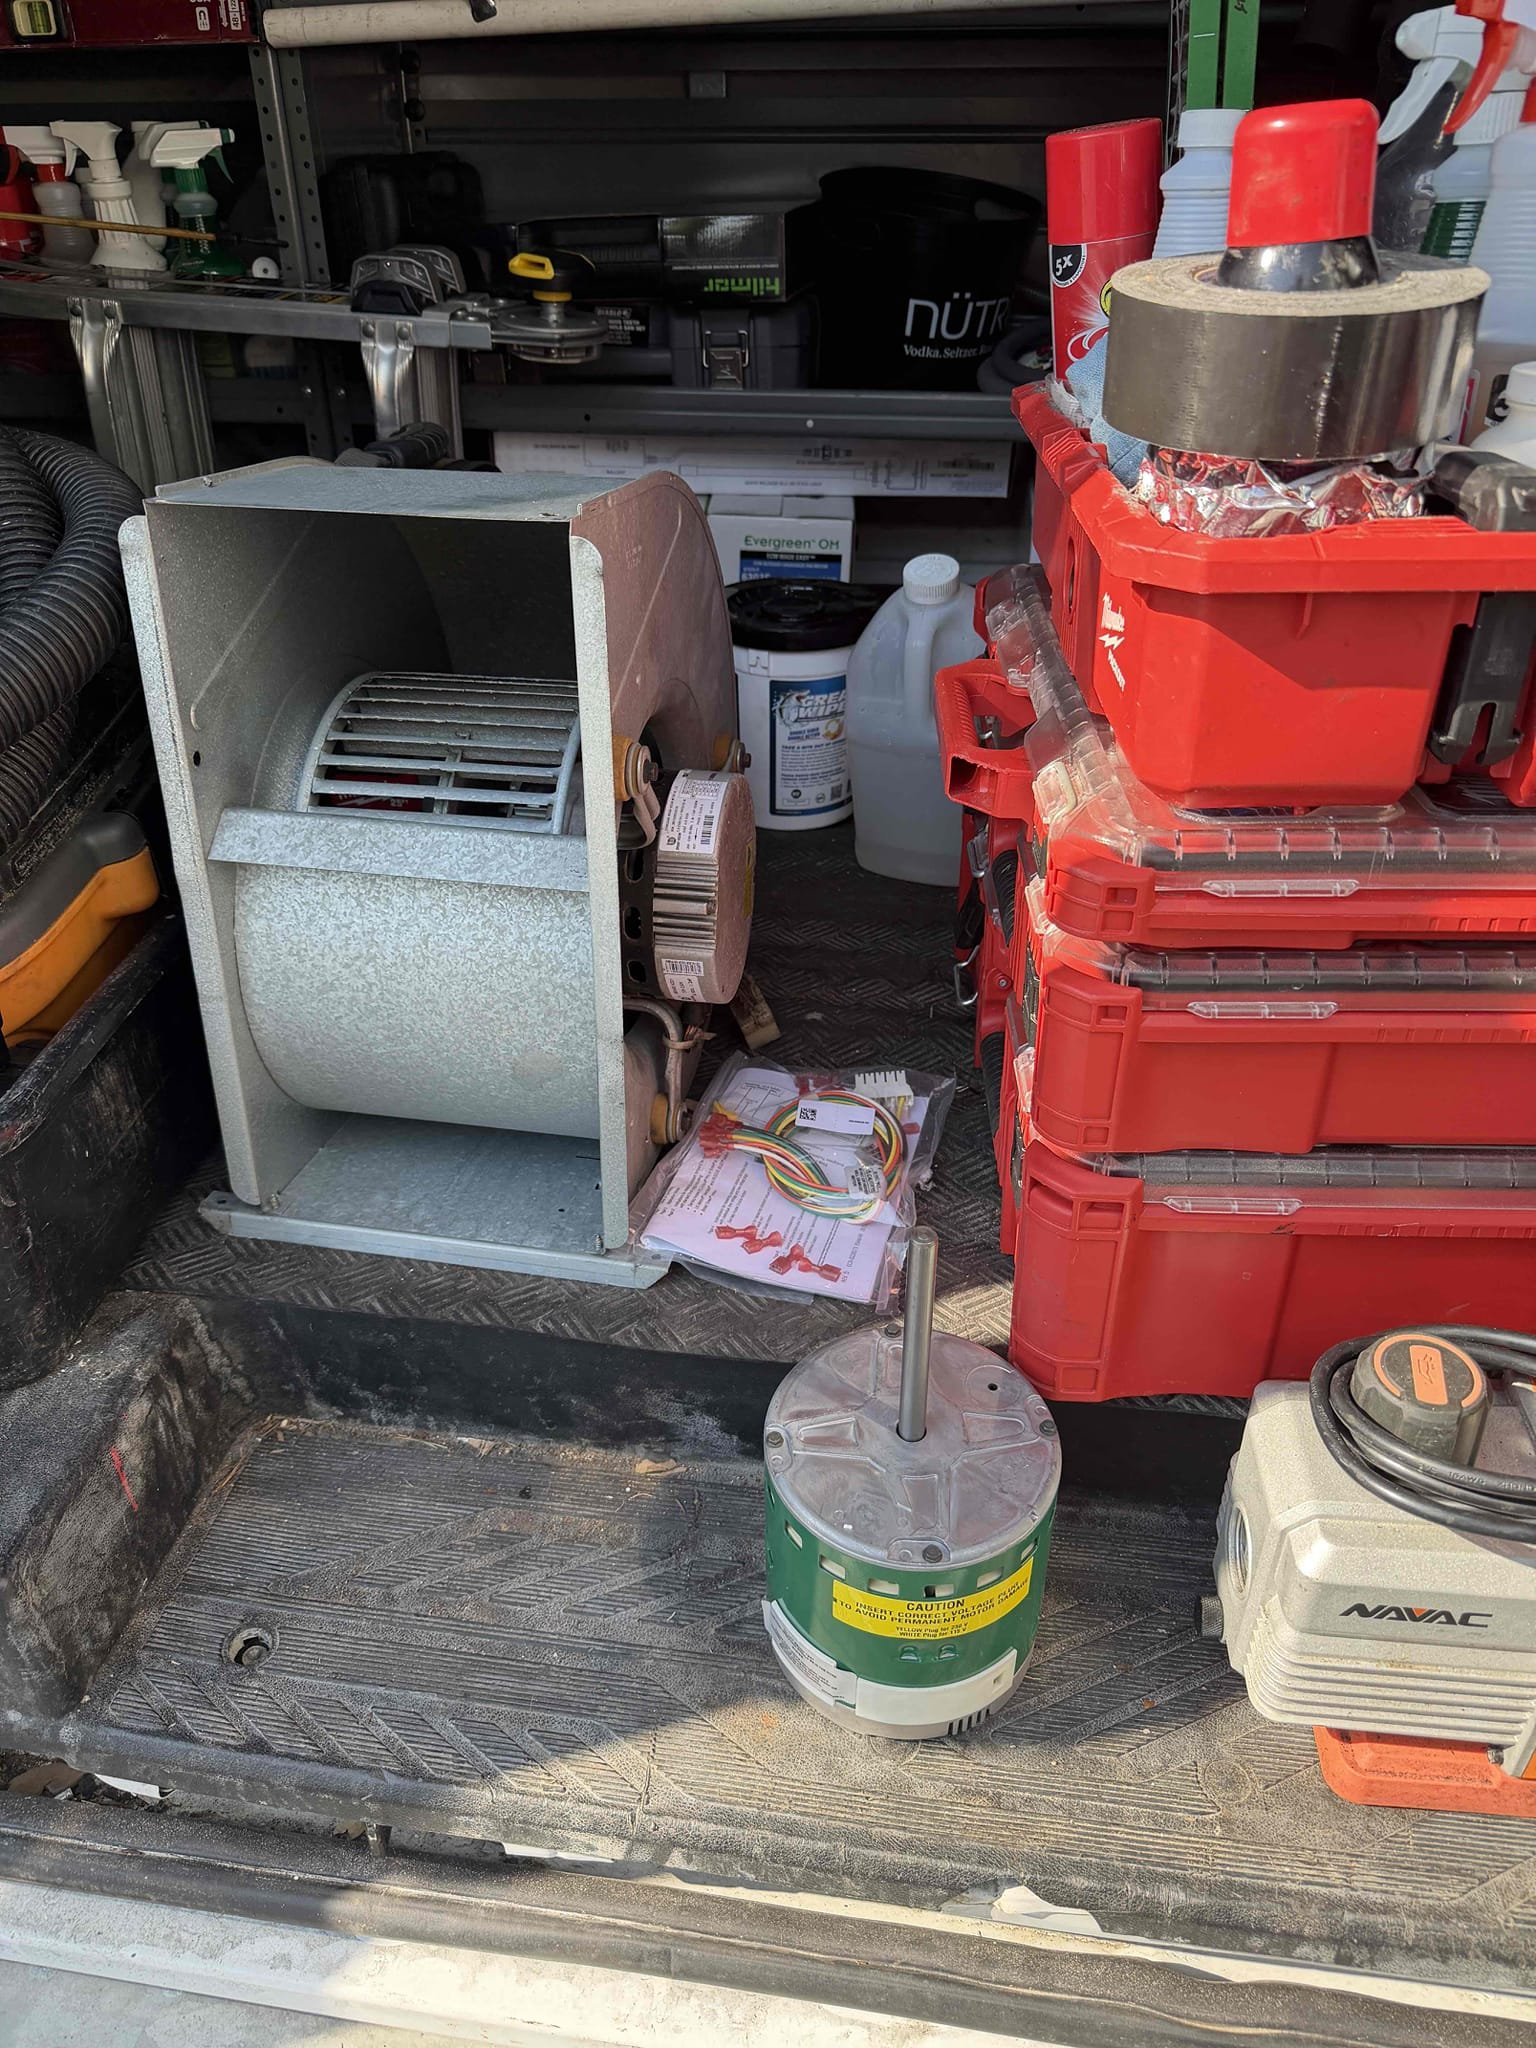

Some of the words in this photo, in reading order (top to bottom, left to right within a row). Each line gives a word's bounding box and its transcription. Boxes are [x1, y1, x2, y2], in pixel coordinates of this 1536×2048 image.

[839, 1601, 852, 1610] TO
[855, 1606, 887, 1621] AVOID
[891, 1612, 958, 1625] PERMANENT
[960, 1603, 995, 1621] MOTOR
[855, 1601, 893, 1616] INSERT
[897, 1610, 947, 1620] CORRECT
[951, 1598, 995, 1617] VOLTAGE
[906, 1599, 965, 1612] CAUTION
[1338, 1602, 1494, 1628] NAVAC
